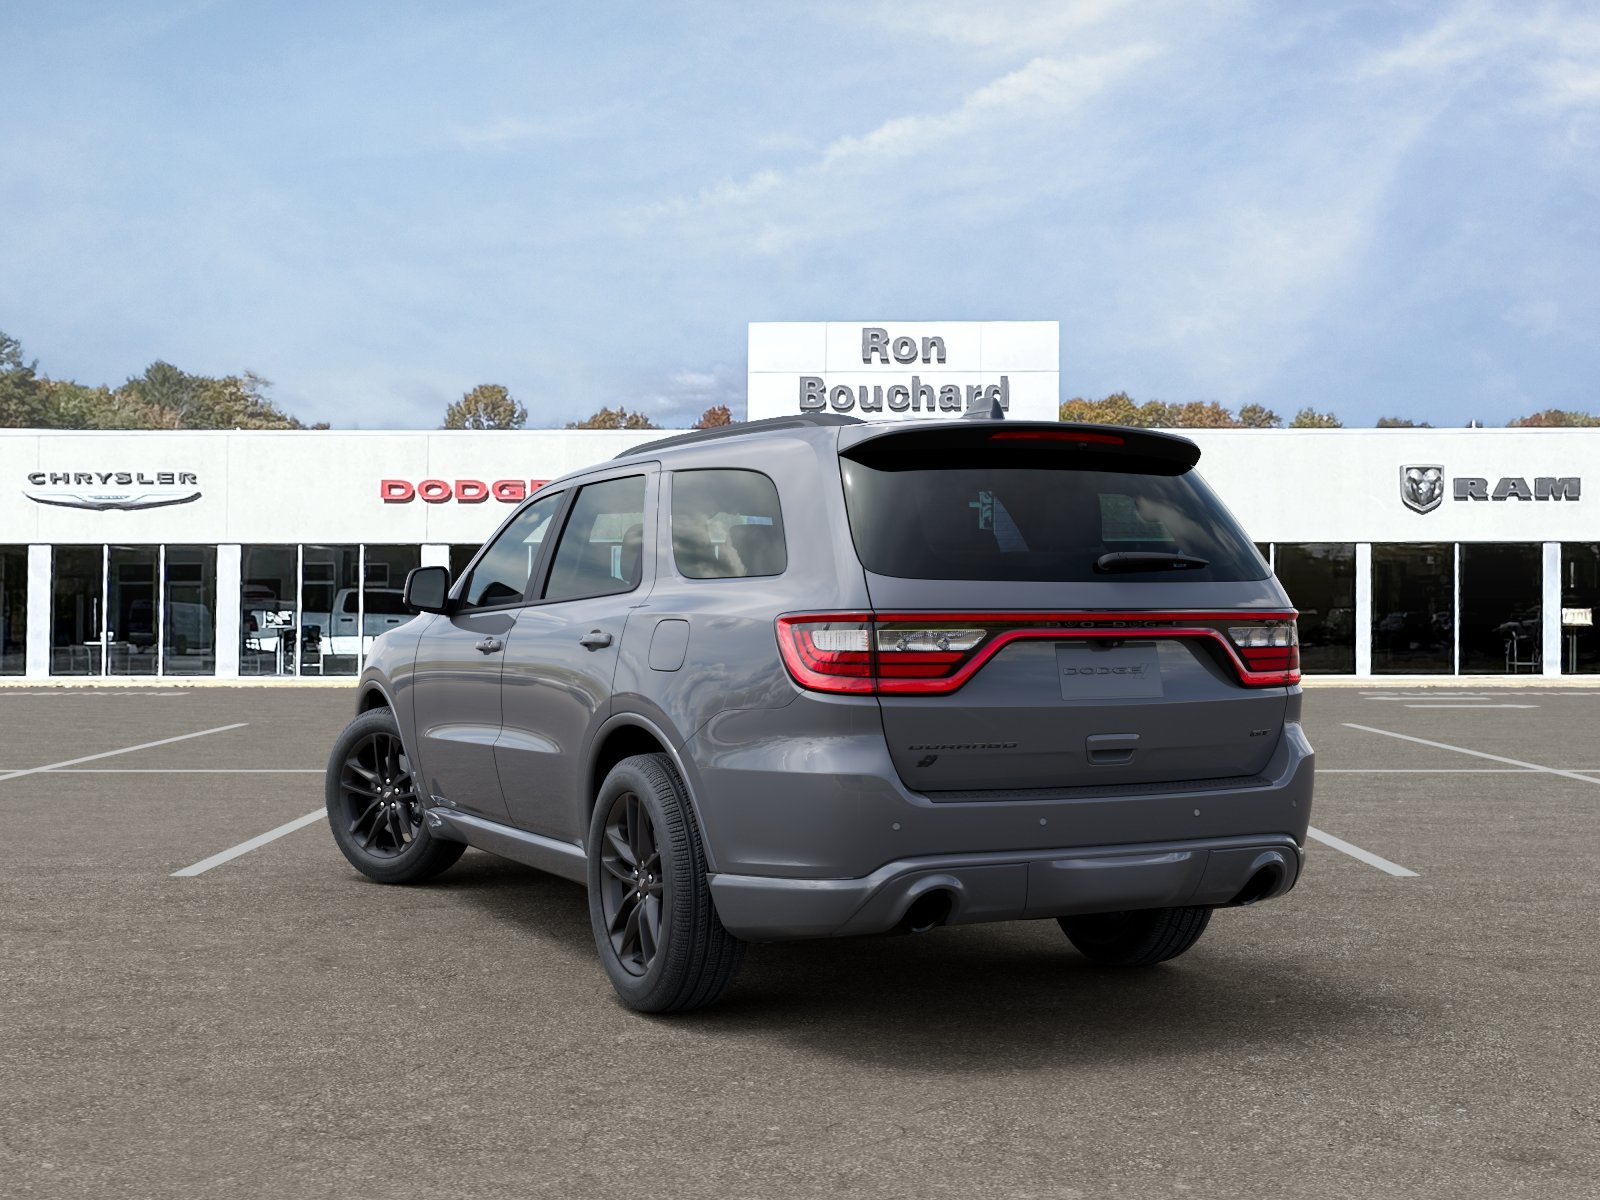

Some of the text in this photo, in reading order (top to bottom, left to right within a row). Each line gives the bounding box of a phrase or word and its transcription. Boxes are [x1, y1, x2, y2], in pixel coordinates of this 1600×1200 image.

[862, 327, 947, 364] Ron
[799, 375, 1009, 412] Bouchard
[27, 472, 198, 485] CHRYSLER
[1453, 477, 1581, 501] RAM
[380, 479, 552, 504] DODG
